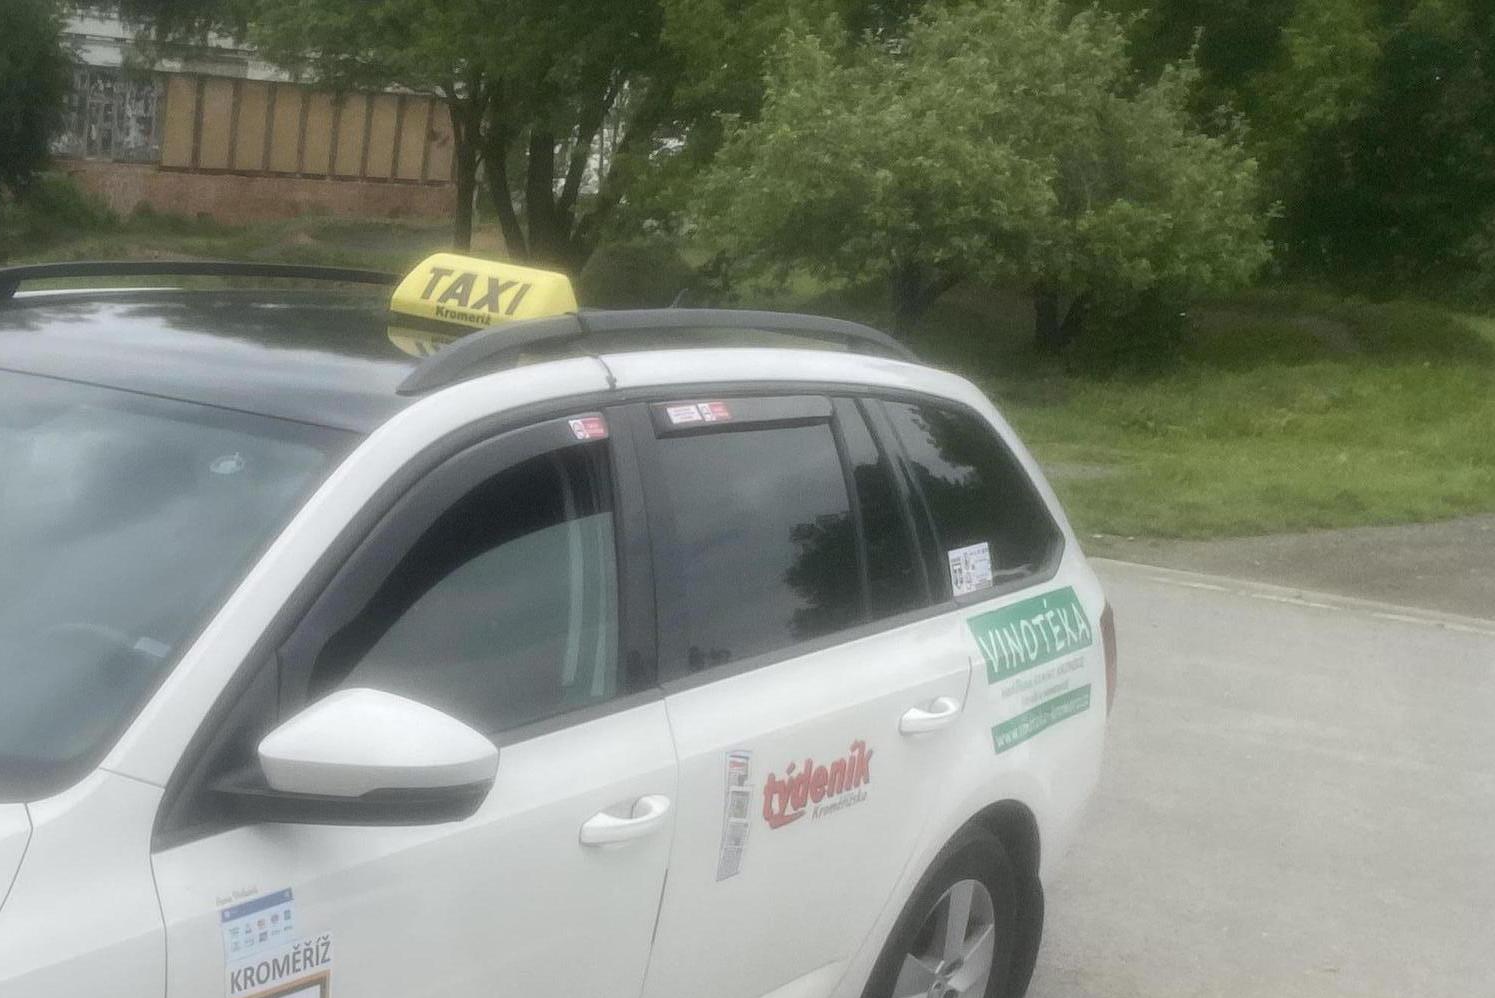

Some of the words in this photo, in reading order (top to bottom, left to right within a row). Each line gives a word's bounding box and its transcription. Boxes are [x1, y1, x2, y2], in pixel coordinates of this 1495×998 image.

[421, 267, 532, 315] TAXI
[763, 740, 873, 830] týdeník
[230, 935, 332, 994] KROMĚŘÍŽ
